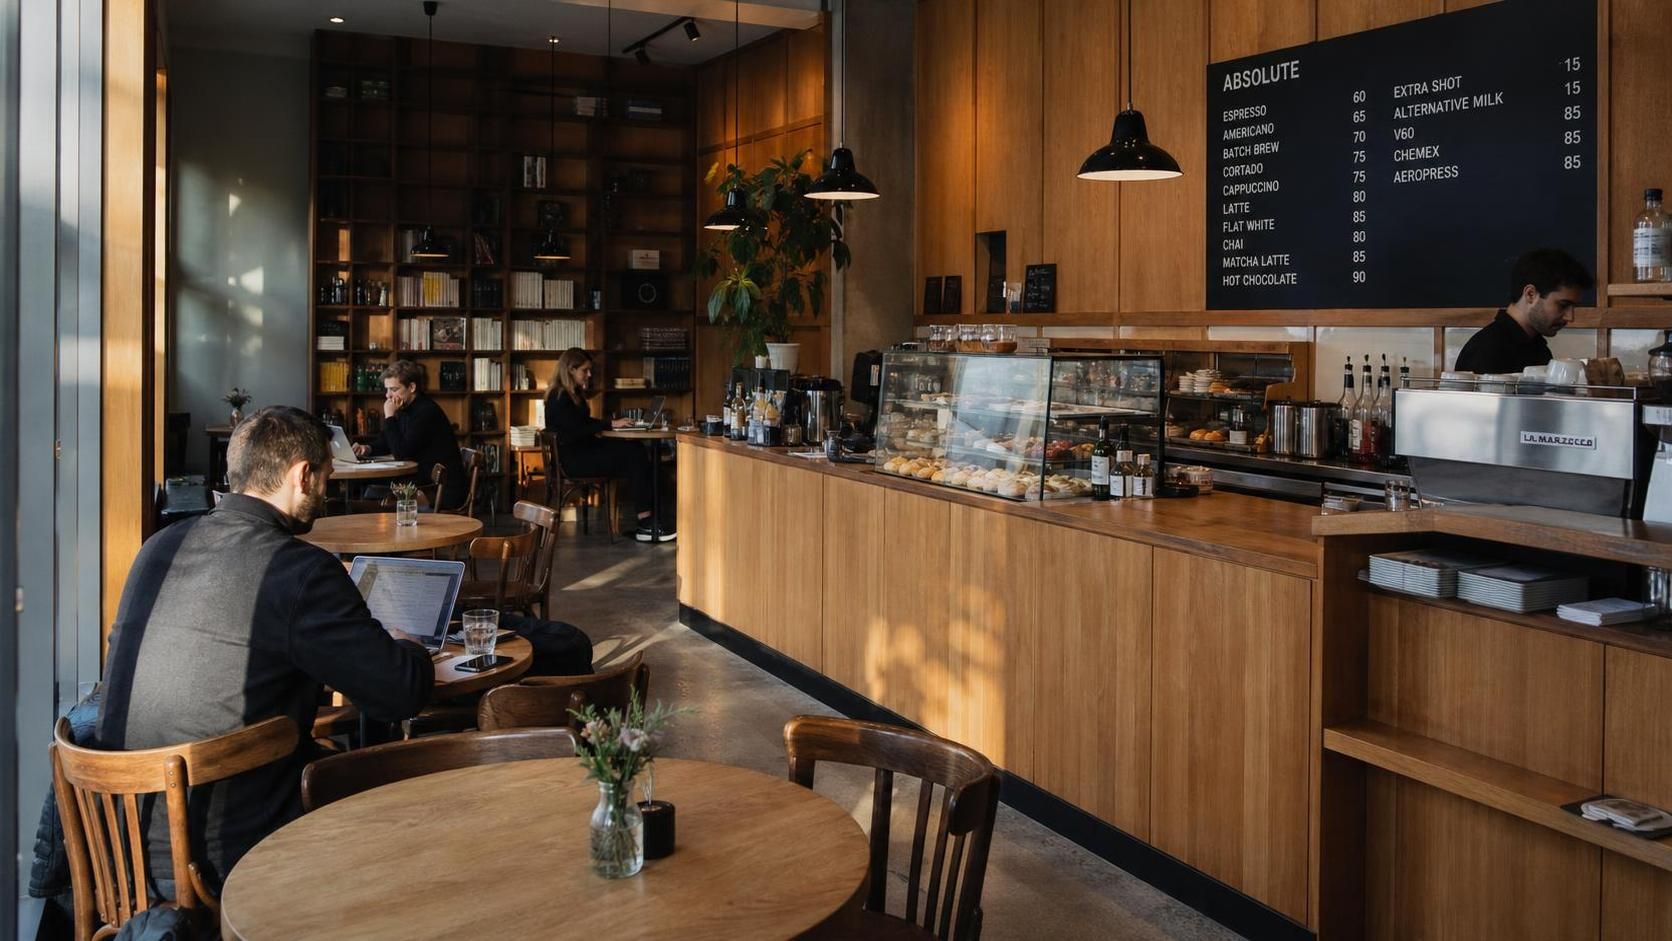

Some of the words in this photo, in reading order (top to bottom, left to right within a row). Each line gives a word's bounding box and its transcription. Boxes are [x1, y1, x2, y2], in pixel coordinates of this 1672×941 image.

[1564, 57, 1581, 72] 15
[1223, 60, 1300, 91] ABSOLUTE
[1393, 82, 1429, 98] EXTRA
[1432, 76, 1462, 92] SHOT
[1564, 81, 1581, 95] 15
[1353, 90, 1366, 103] 60
[1393, 97, 1469, 119] ALTERNATIVE
[1473, 92, 1504, 108] MILK
[1223, 105, 1267, 122] ESPRESSO
[1353, 110, 1366, 123] 65
[1564, 106, 1581, 120] 85
[1223, 123, 1275, 141] AMERICANO
[1353, 131, 1366, 143] 70
[1393, 127, 1415, 141] V60
[1564, 130, 1581, 145] 85
[1223, 145, 1251, 159] BATCH
[1253, 141, 1280, 155] BREW
[1353, 151, 1366, 163] 75
[1393, 145, 1440, 162] CHEMEX
[1564, 155, 1581, 169] 85
[1223, 163, 1264, 178] CORTADO
[1353, 171, 1366, 183] 75
[1393, 165, 1459, 183] AEROPRESS
[1223, 180, 1280, 196] CAPPUCCINO
[1353, 191, 1366, 203] 80
[1223, 202, 1250, 215] LATTE
[1353, 211, 1366, 223] 85
[1223, 220, 1244, 233] FLAT
[1246, 218, 1275, 231] WHITE
[1353, 231, 1366, 243] 80
[1223, 239, 1244, 251] CHAI
[1223, 255, 1259, 268] MATCHA
[1261, 254, 1290, 267] LATTE
[1353, 251, 1366, 263] 85
[1223, 275, 1240, 287] HOT
[1242, 273, 1297, 286] CHOCOLATE
[1353, 271, 1366, 283] 90
